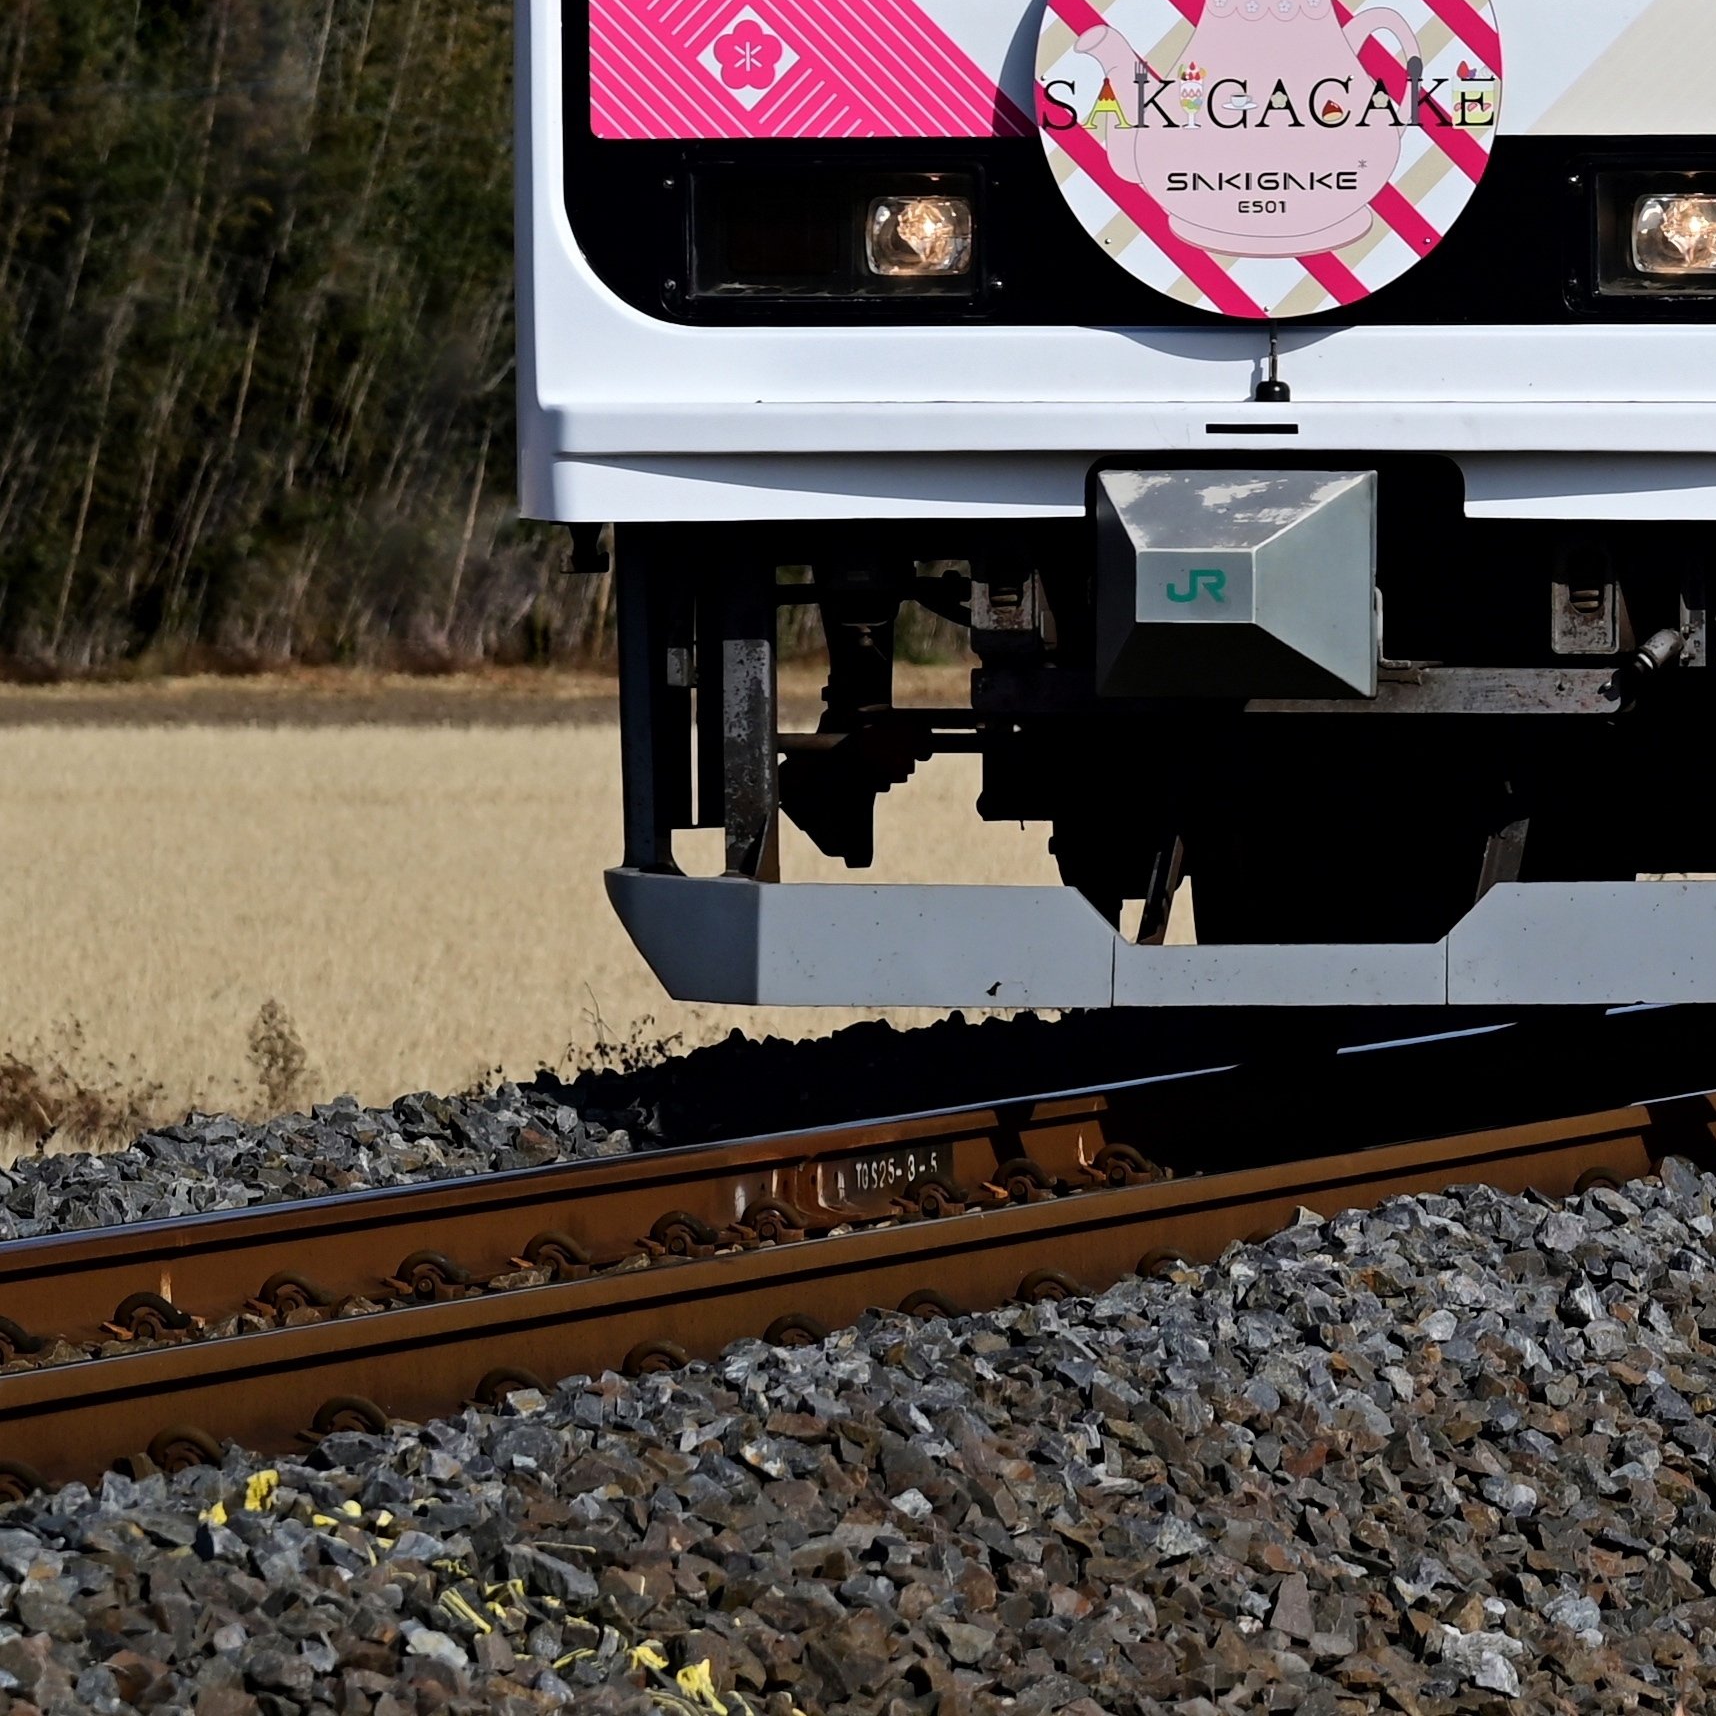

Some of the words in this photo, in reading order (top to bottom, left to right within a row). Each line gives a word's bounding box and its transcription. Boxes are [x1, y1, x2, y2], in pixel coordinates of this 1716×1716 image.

[1166, 171, 1358, 192] SAKIGAKE
[1237, 200, 1287, 215] E501
[1166, 568, 1227, 603] JR
